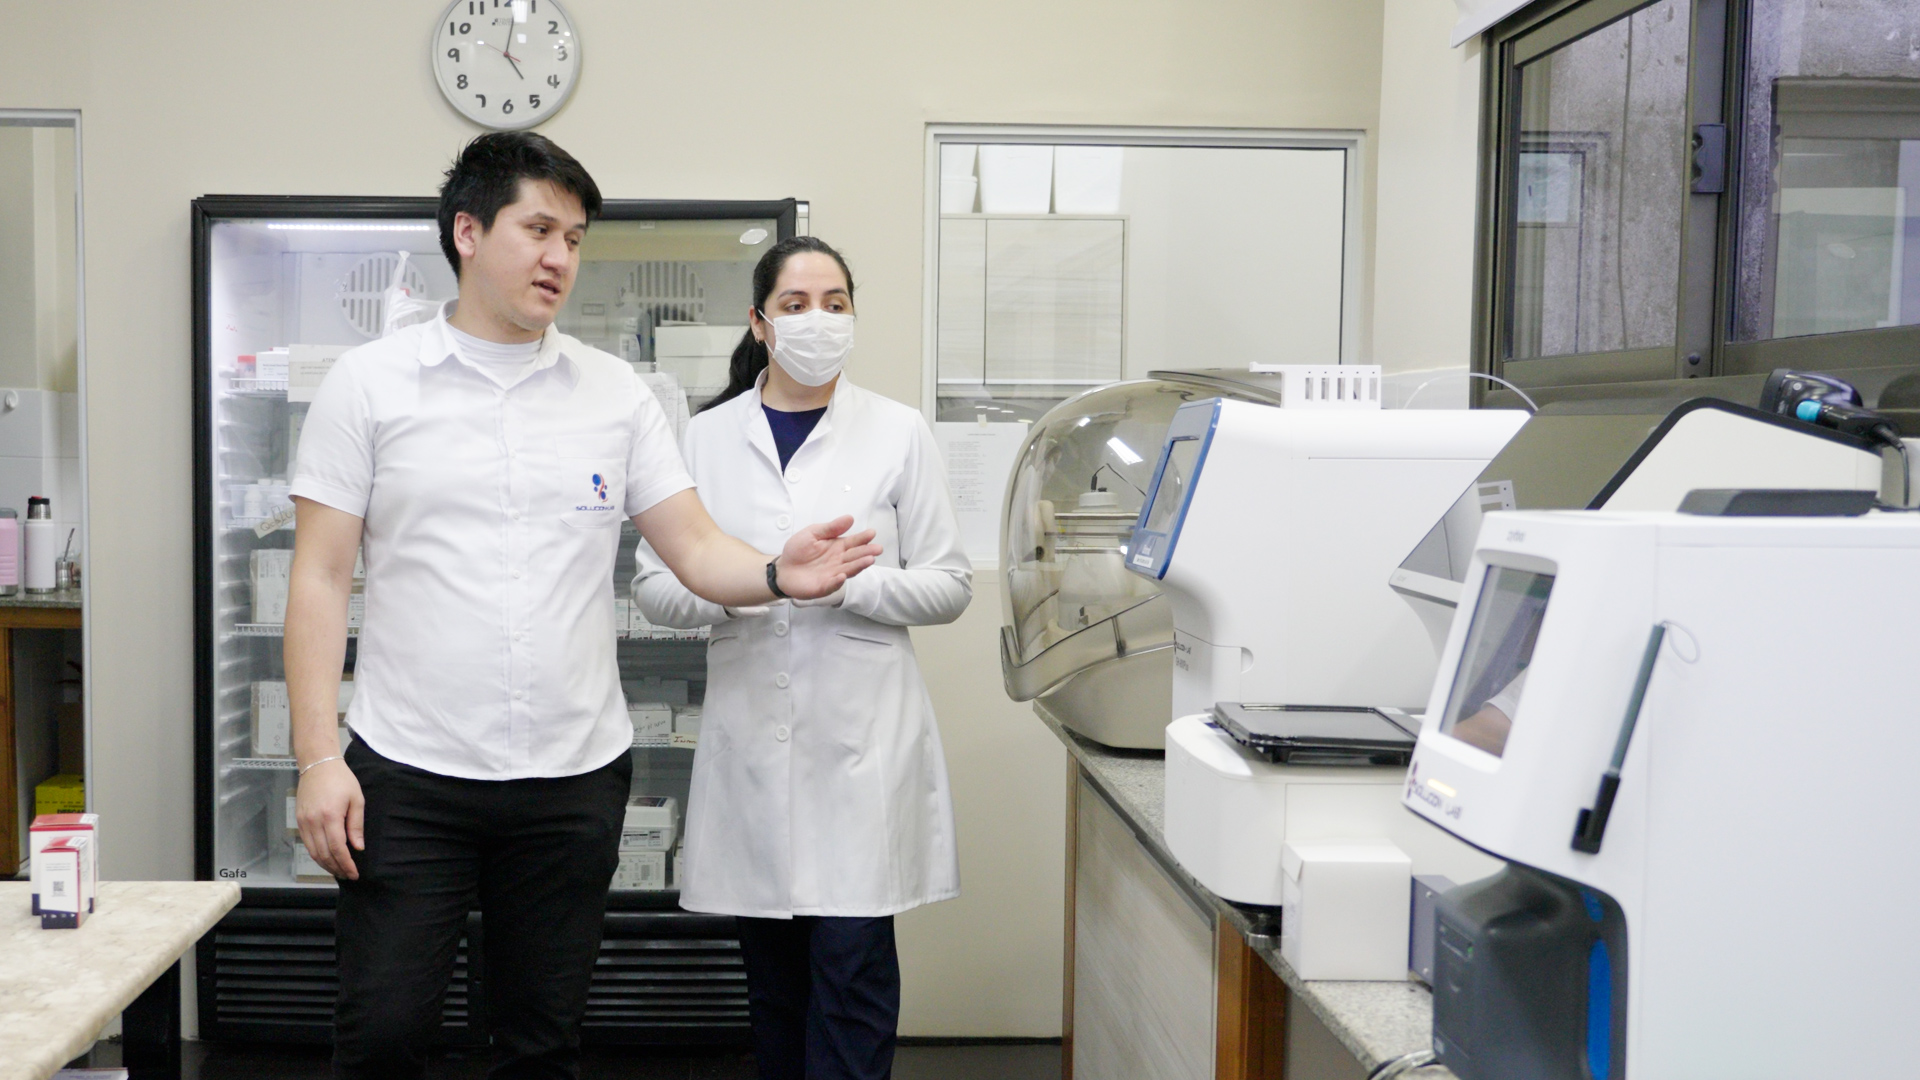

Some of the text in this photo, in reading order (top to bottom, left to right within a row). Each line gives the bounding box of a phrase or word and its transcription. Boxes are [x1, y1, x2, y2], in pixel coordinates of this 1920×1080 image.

[469, 1, 485, 15] 11
[531, 0, 536, 14] 1
[450, 21, 471, 36] 10
[548, 21, 559, 34] 2
[447, 48, 460, 62] 9
[557, 45, 568, 62] 3
[456, 74, 469, 90] 8
[547, 74, 560, 89] 4
[475, 94, 487, 108] 7
[502, 99, 514, 115] 6
[529, 94, 541, 109] 5
[219, 868, 247, 878] Gafa
